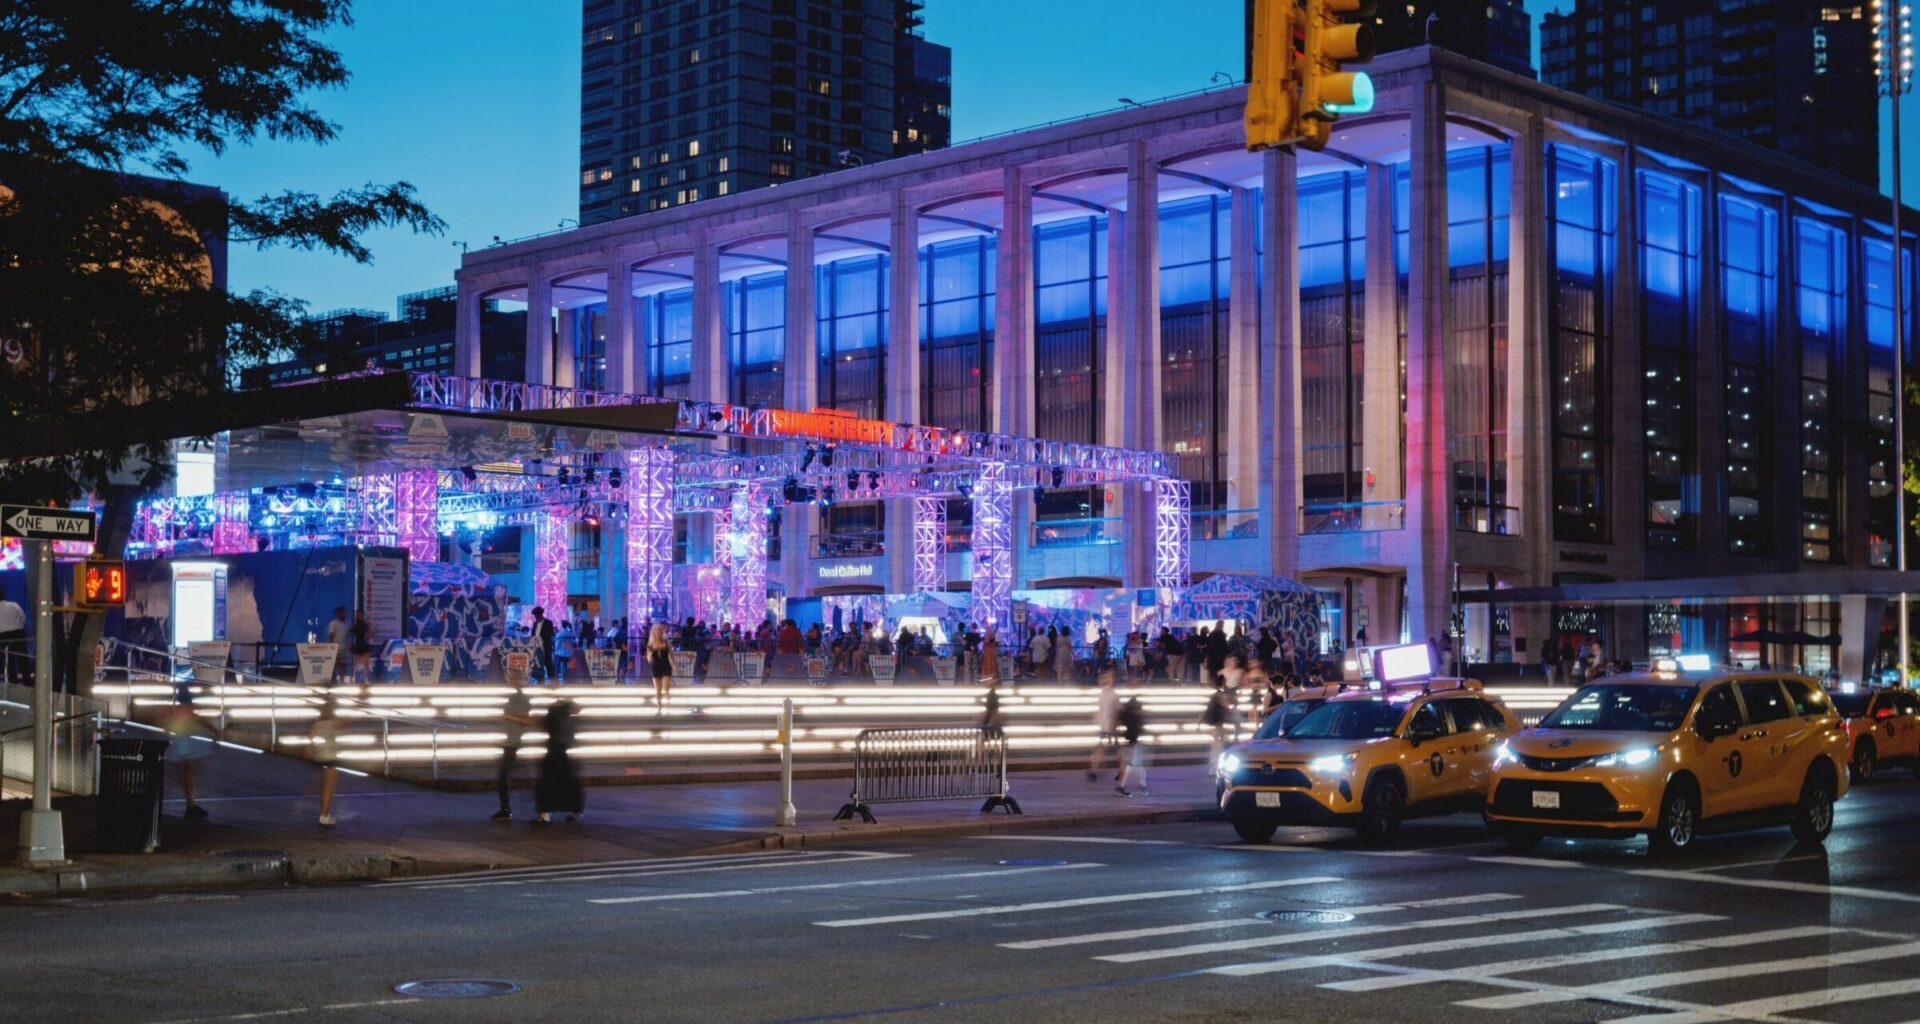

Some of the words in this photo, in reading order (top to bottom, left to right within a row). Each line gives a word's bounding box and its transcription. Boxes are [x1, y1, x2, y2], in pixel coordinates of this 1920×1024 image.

[773, 409, 845, 440] SUMMER
[857, 419, 894, 445] CITY
[16, 516, 43, 530] ONE
[56, 518, 84, 533] WAY
[111, 570, 121, 599] 9
